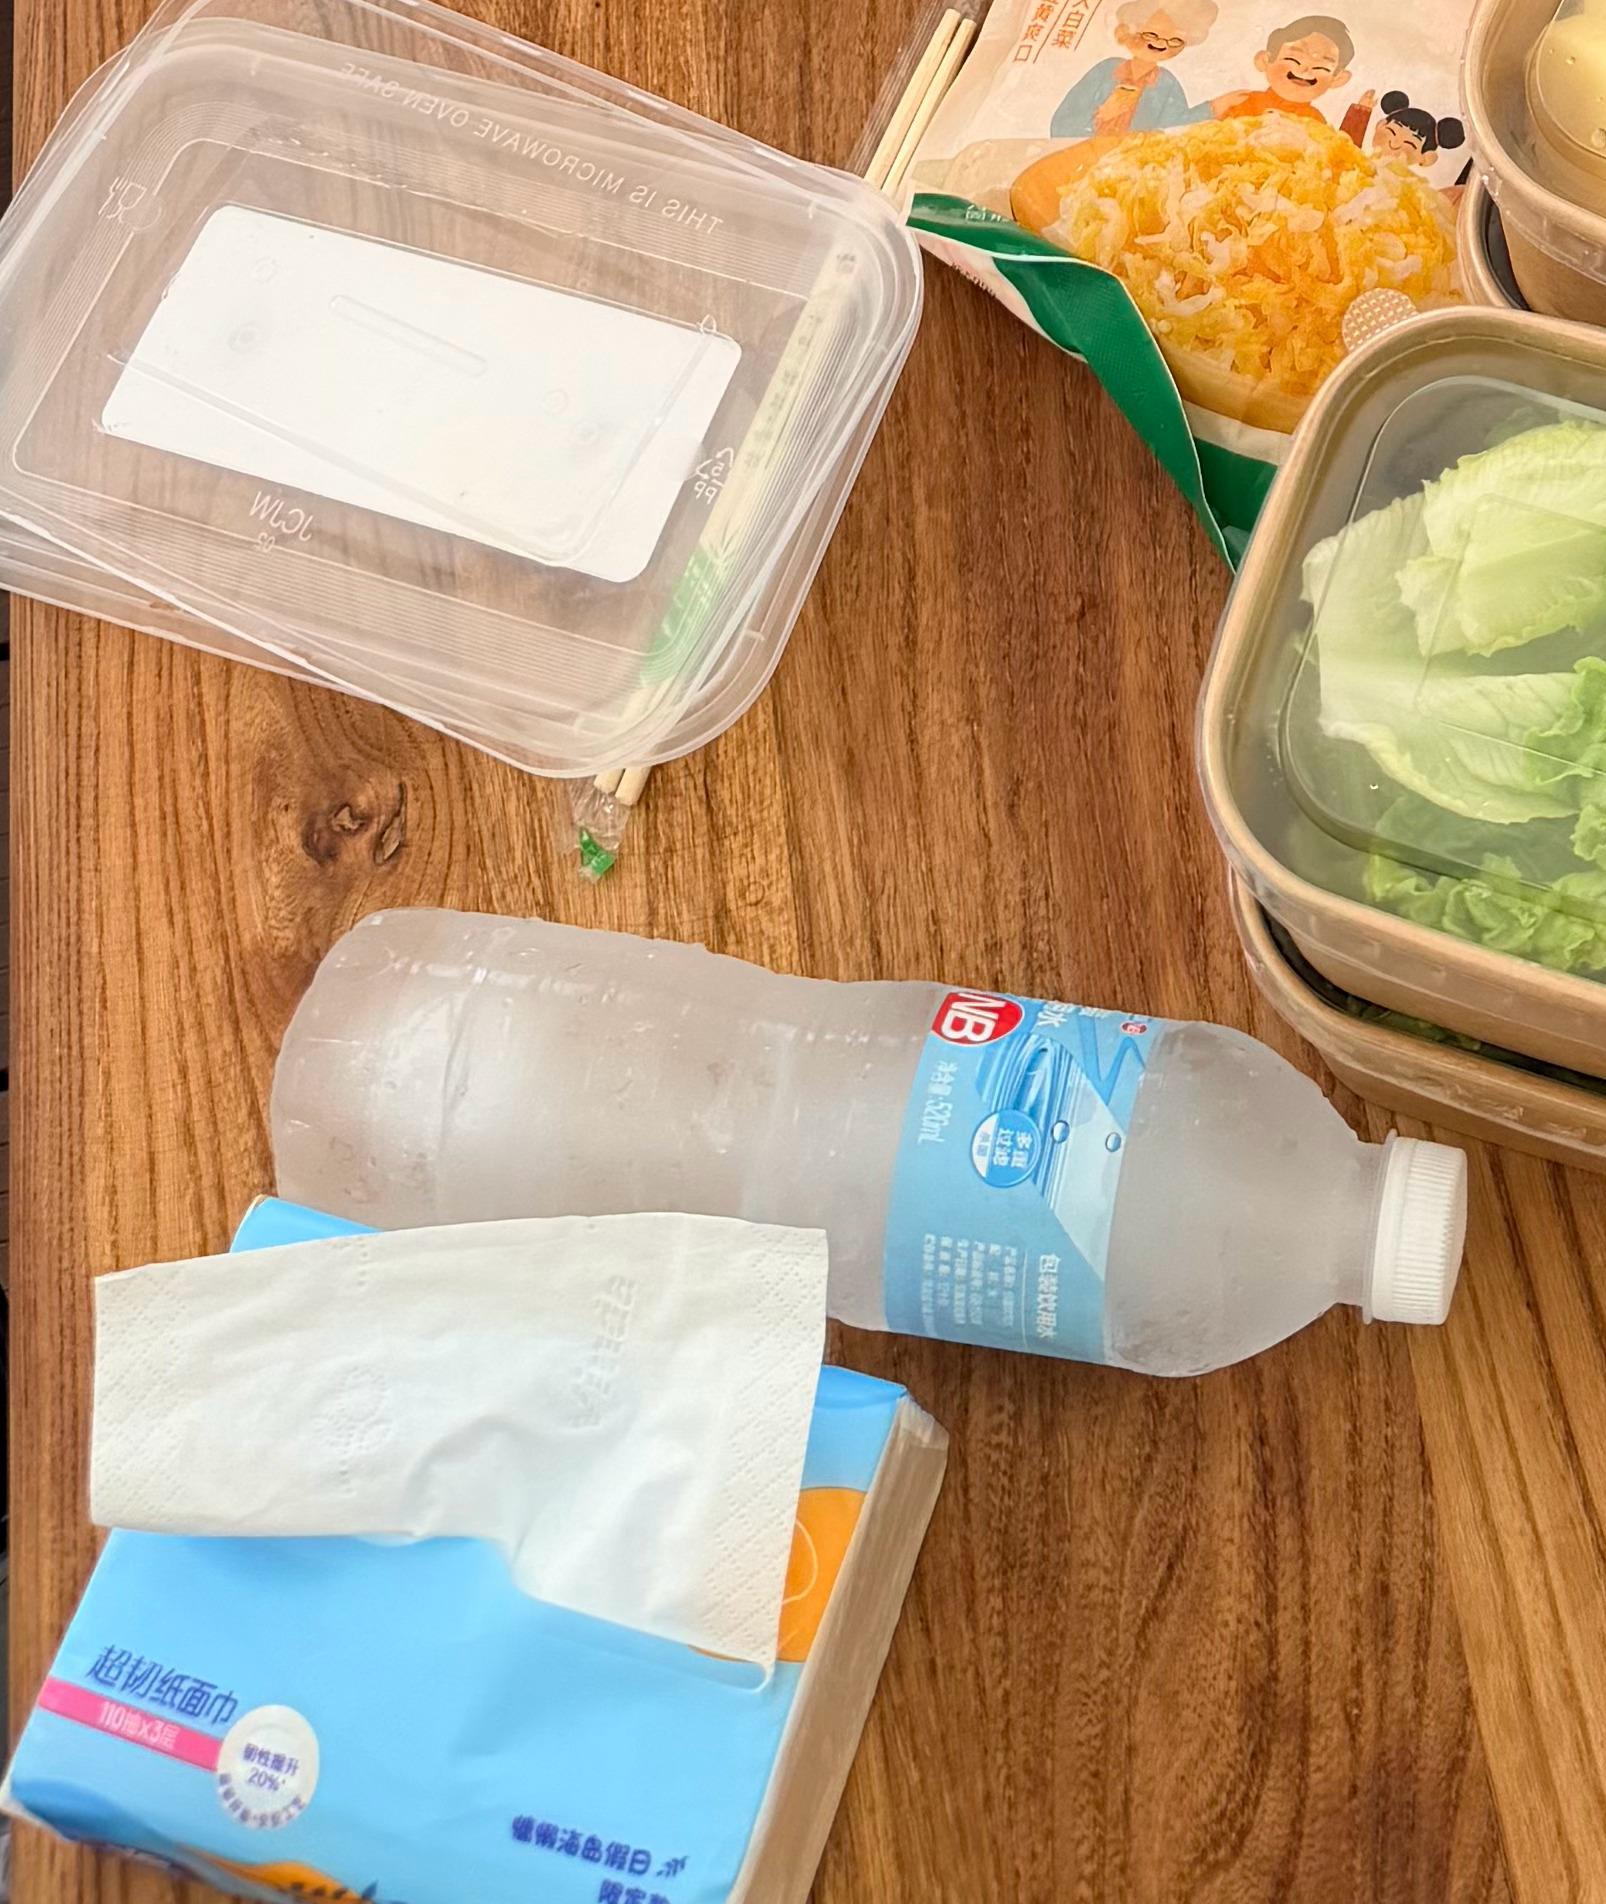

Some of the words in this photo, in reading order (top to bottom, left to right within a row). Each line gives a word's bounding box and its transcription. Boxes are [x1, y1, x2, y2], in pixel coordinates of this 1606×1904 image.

[941, 992, 1005, 1043] NB
[86, 1644, 239, 1725] 超韧纸面巾
